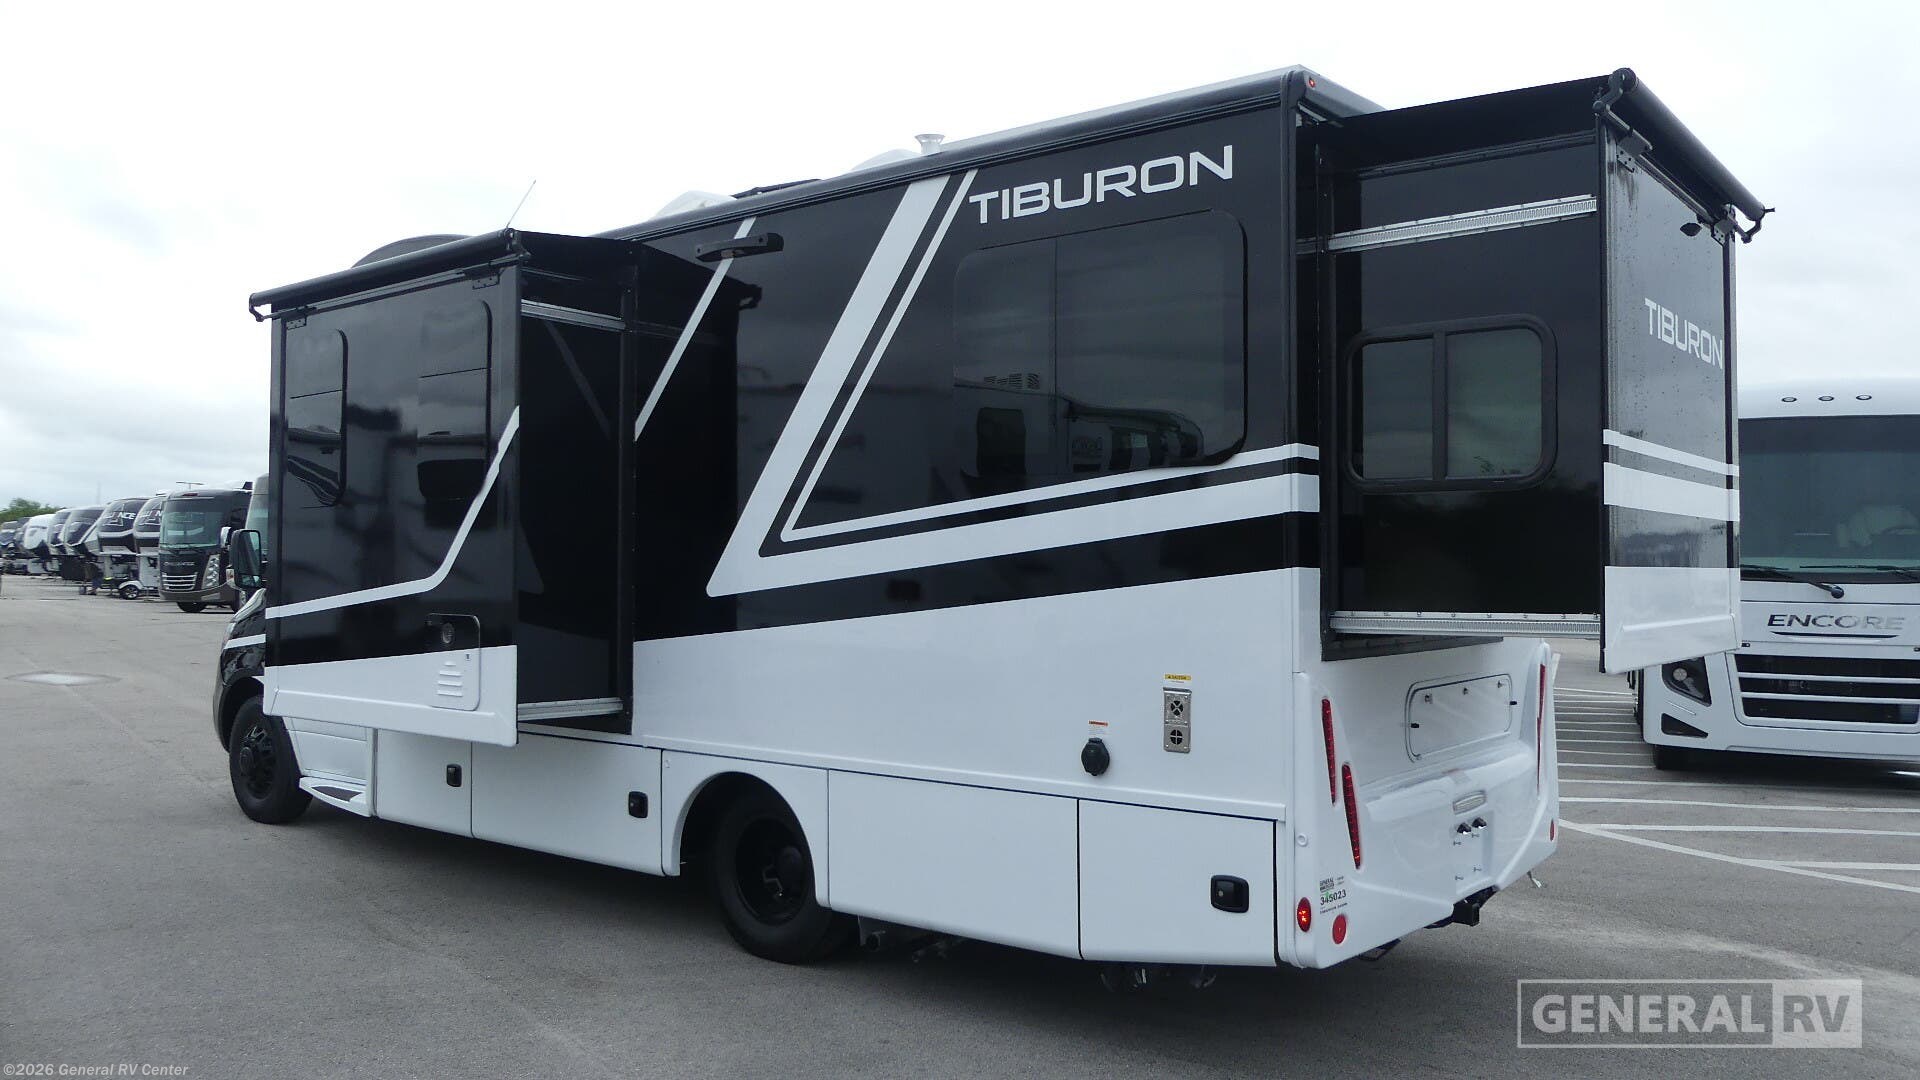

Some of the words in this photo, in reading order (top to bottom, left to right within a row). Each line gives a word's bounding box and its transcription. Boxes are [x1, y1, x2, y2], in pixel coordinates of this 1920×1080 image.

[969, 145, 1233, 224] TIBURON
[1644, 297, 1723, 370] TIBURON
[1767, 614, 1905, 630] ENCORE
[1320, 889, 1347, 906] 345023
